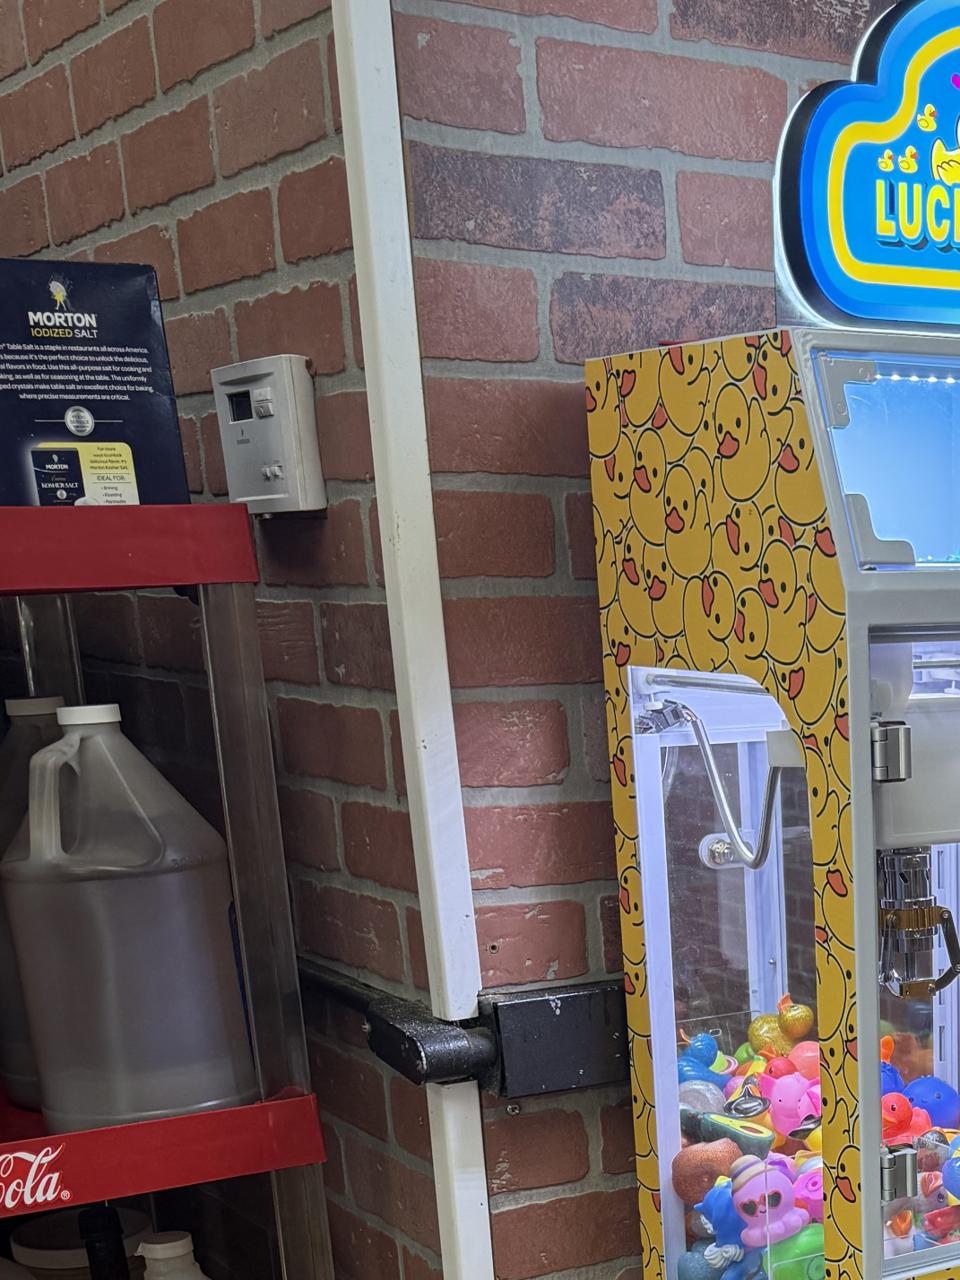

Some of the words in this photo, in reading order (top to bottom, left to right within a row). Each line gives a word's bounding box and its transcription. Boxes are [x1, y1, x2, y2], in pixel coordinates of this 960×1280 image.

[28, 312, 97, 328] MORTON
[31, 328, 73, 338] IODIZED
[74, 329, 98, 339] SALT
[49, 354, 69, 362] perfect
